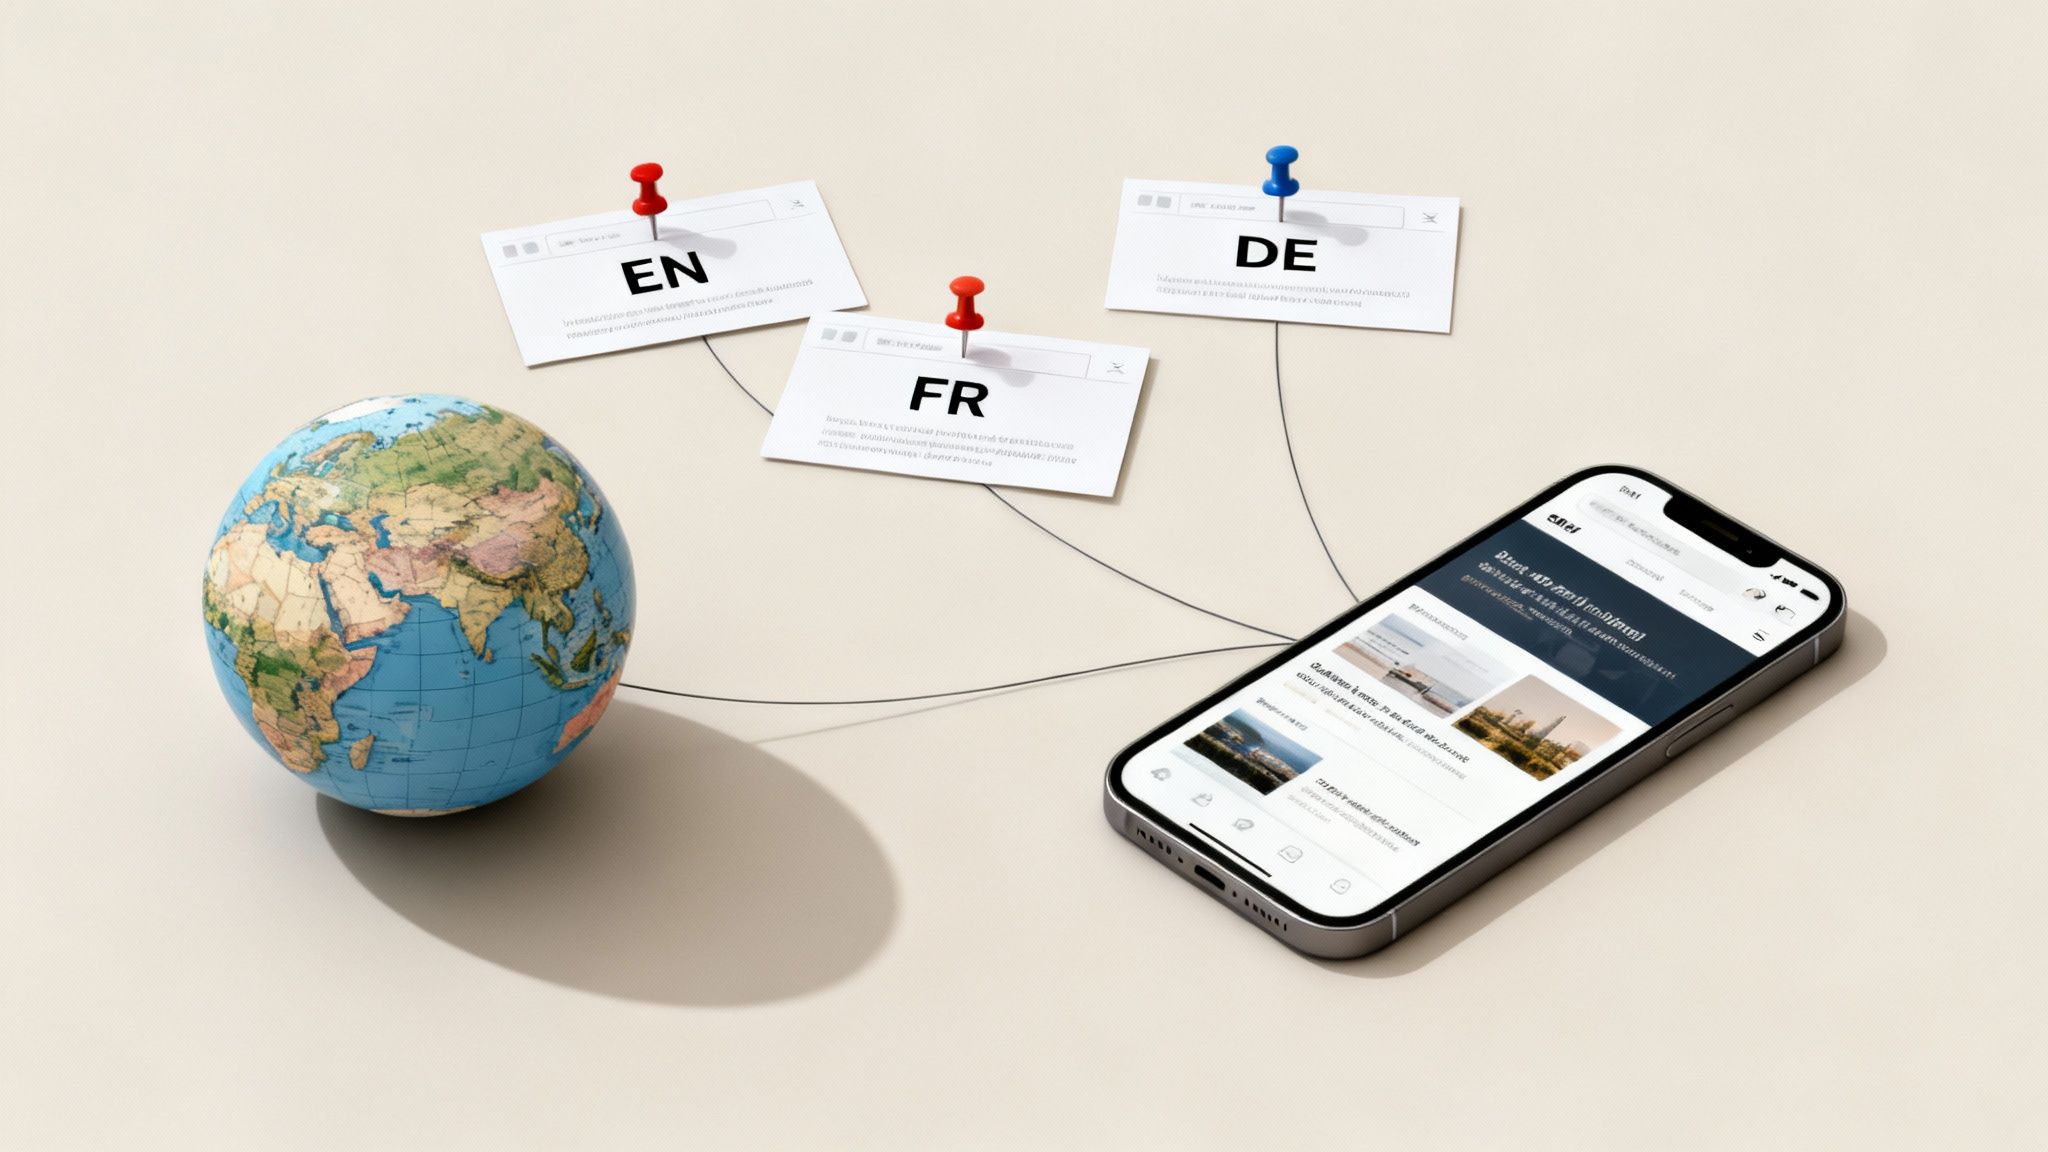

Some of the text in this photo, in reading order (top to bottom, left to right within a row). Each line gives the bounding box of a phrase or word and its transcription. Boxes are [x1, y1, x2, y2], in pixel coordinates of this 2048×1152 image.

[621, 252, 709, 296] EN
[1236, 235, 1318, 272] DE
[909, 375, 989, 418] FR
